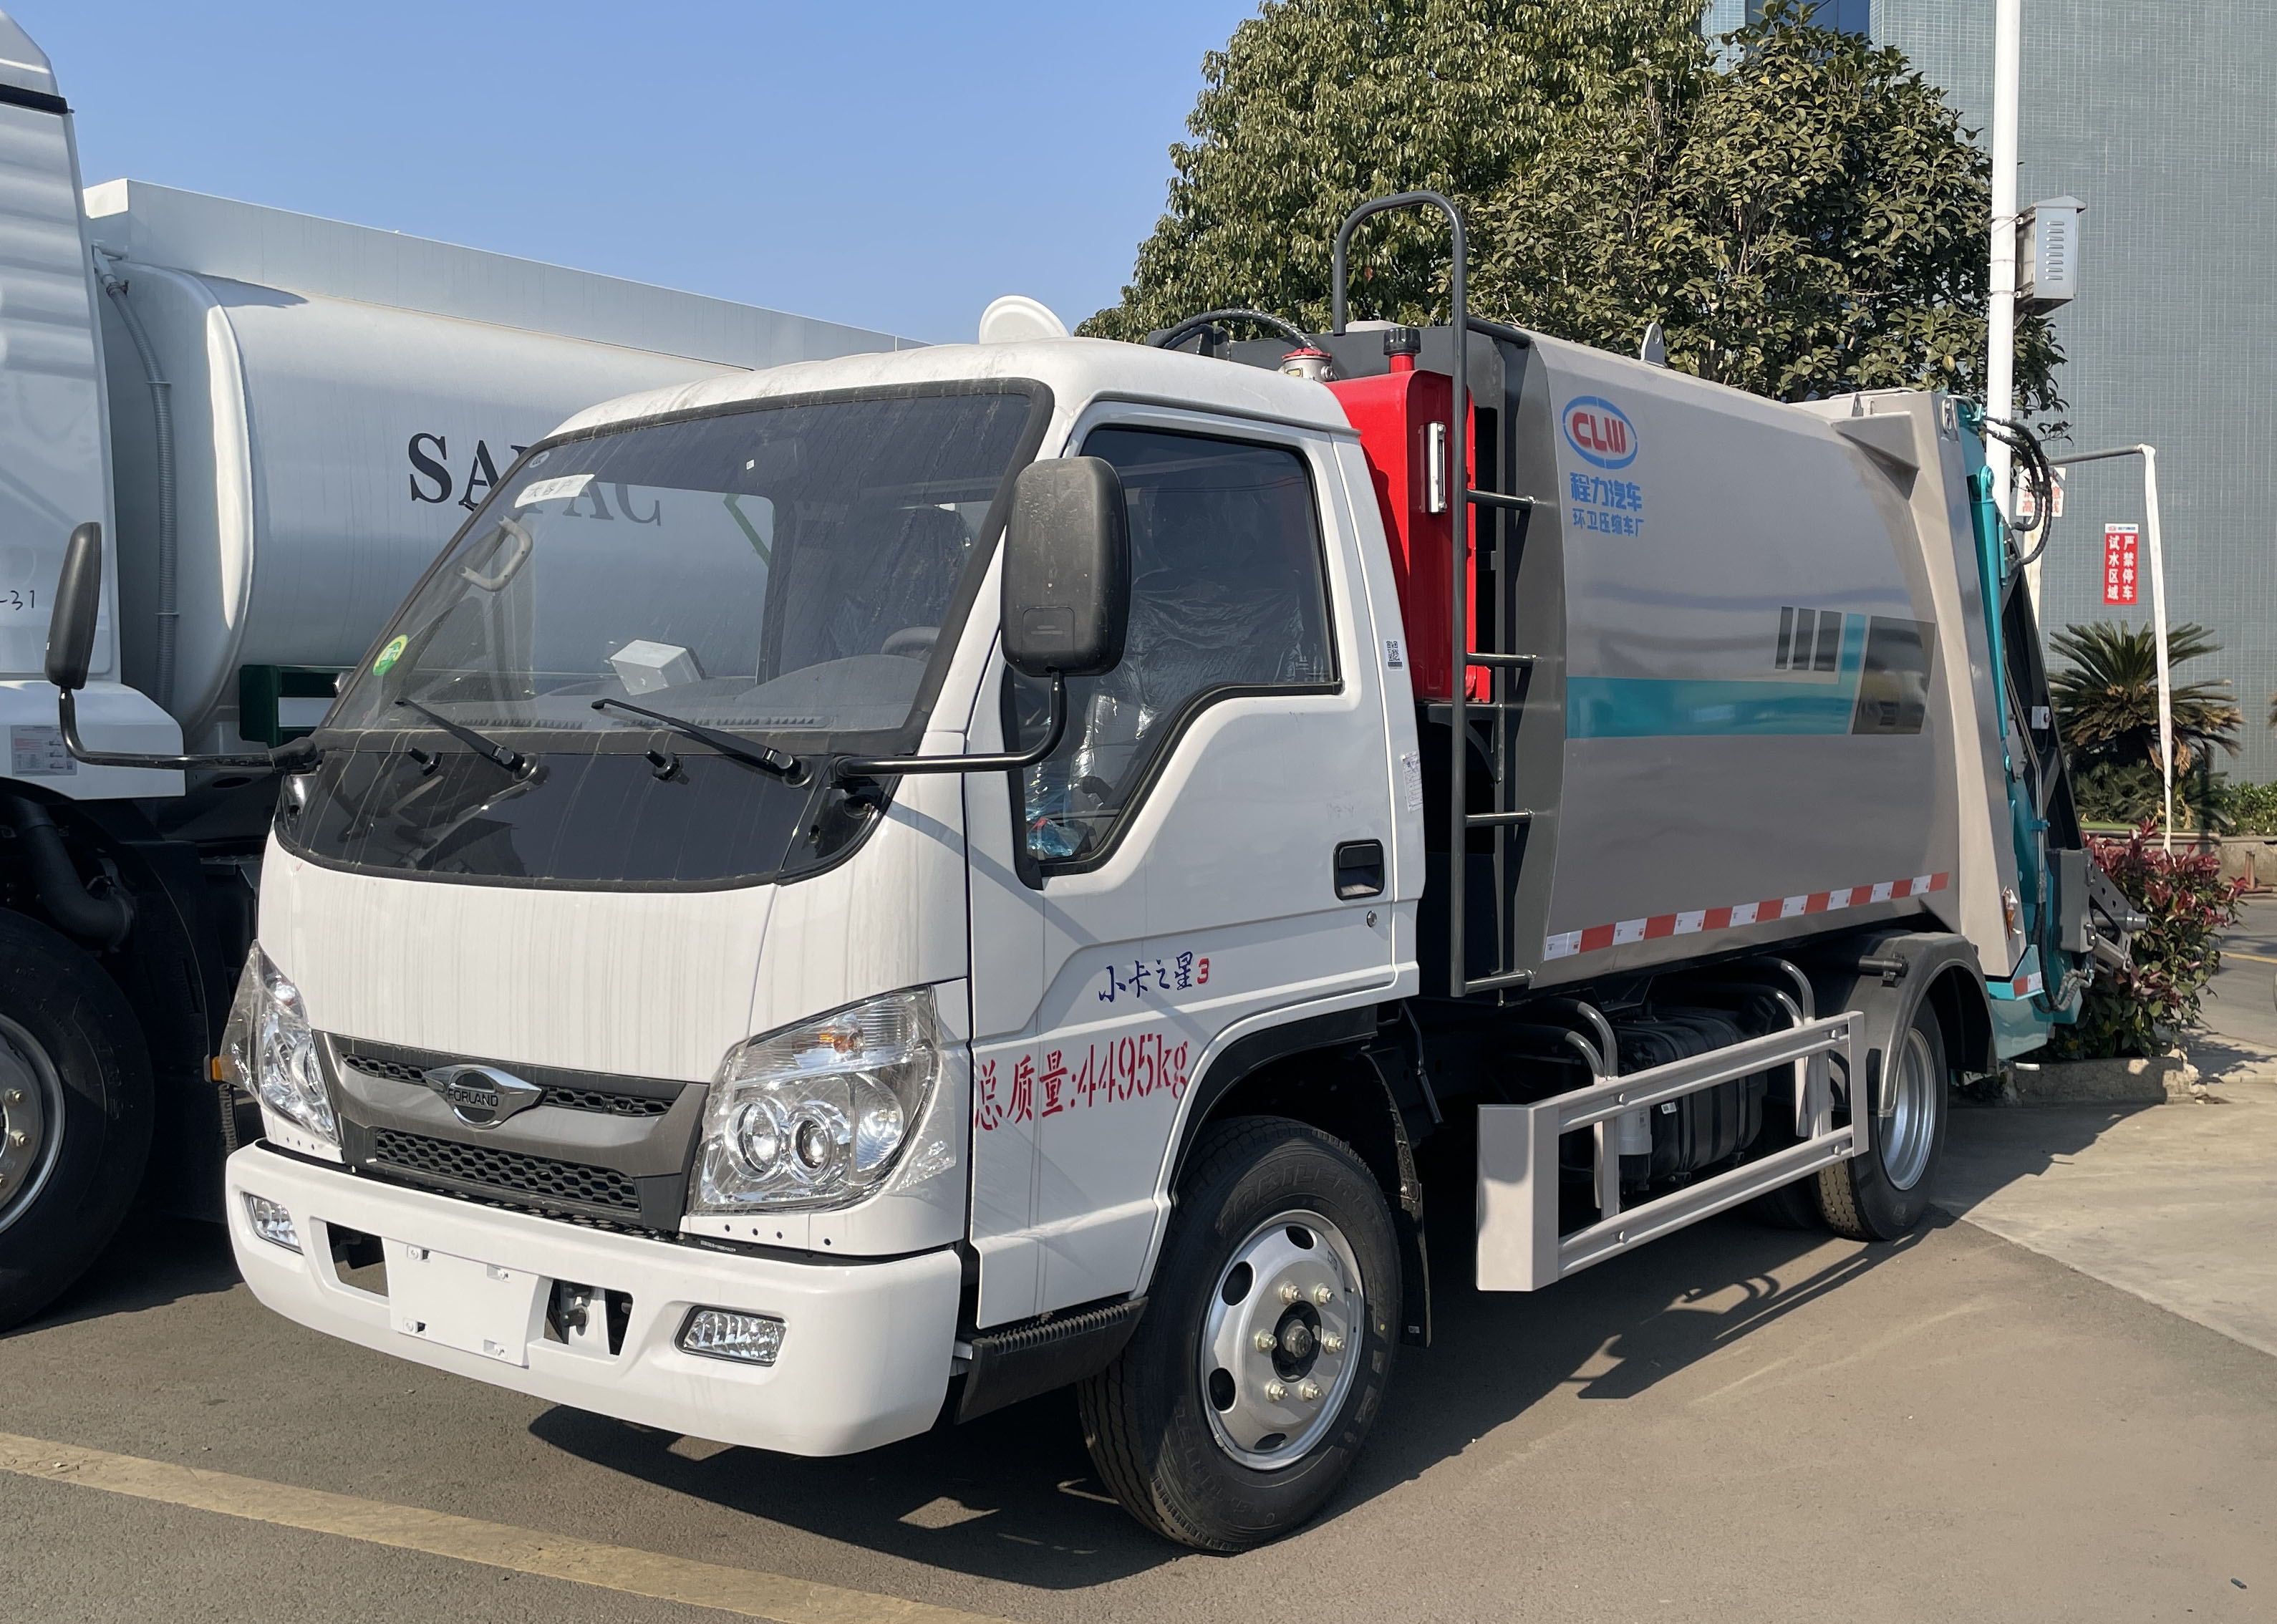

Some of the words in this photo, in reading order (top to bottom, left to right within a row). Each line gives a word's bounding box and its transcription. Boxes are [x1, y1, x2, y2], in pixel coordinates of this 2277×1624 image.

[1572, 412, 1626, 455] CLW
[407, 432, 662, 526] SAAC
[1570, 472, 1643, 511] 程力汽车
[1572, 508, 1645, 537] 环卫压缩车厂
[2107, 535, 2120, 601] 试水区域
[2122, 535, 2135, 601] 严禁停车
[448, 1088, 499, 1107] FORLAND
[975, 1033, 1188, 1131] 总质量:4495kg
